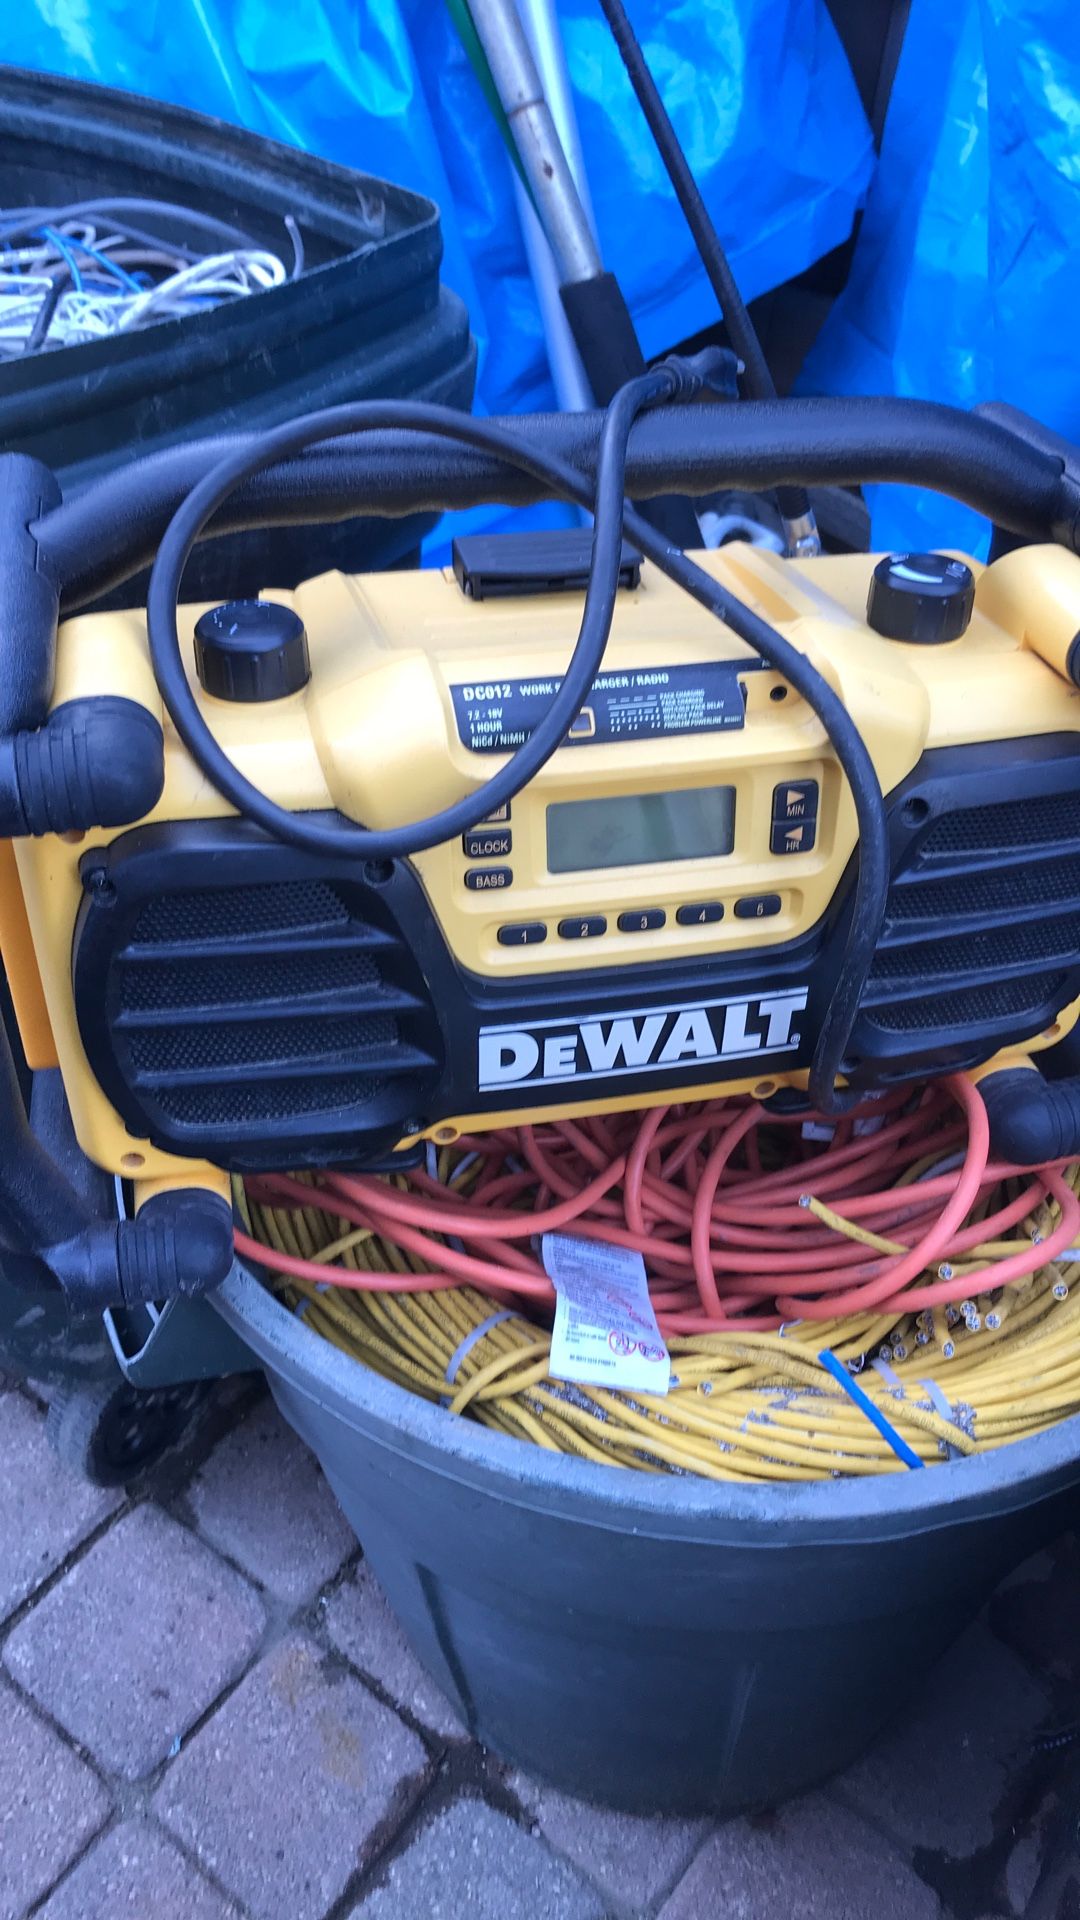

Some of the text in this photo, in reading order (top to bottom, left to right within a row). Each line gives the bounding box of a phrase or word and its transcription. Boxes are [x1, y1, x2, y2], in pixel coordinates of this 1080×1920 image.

[463, 684, 513, 701] DC012
[520, 682, 553, 697] WORK
[592, 676, 629, 690] ARGER
[637, 672, 669, 686] RADIO
[707, 700, 725, 710] DELAY
[488, 707, 503, 720] 18V
[470, 720, 503, 734] 1 HOUR
[786, 803, 805, 817] MIN
[470, 838, 509, 855] CLOCK
[785, 840, 801, 852] HR
[476, 873, 505, 889] BASS
[520, 902, 764, 944] 1 2 3 4 5
